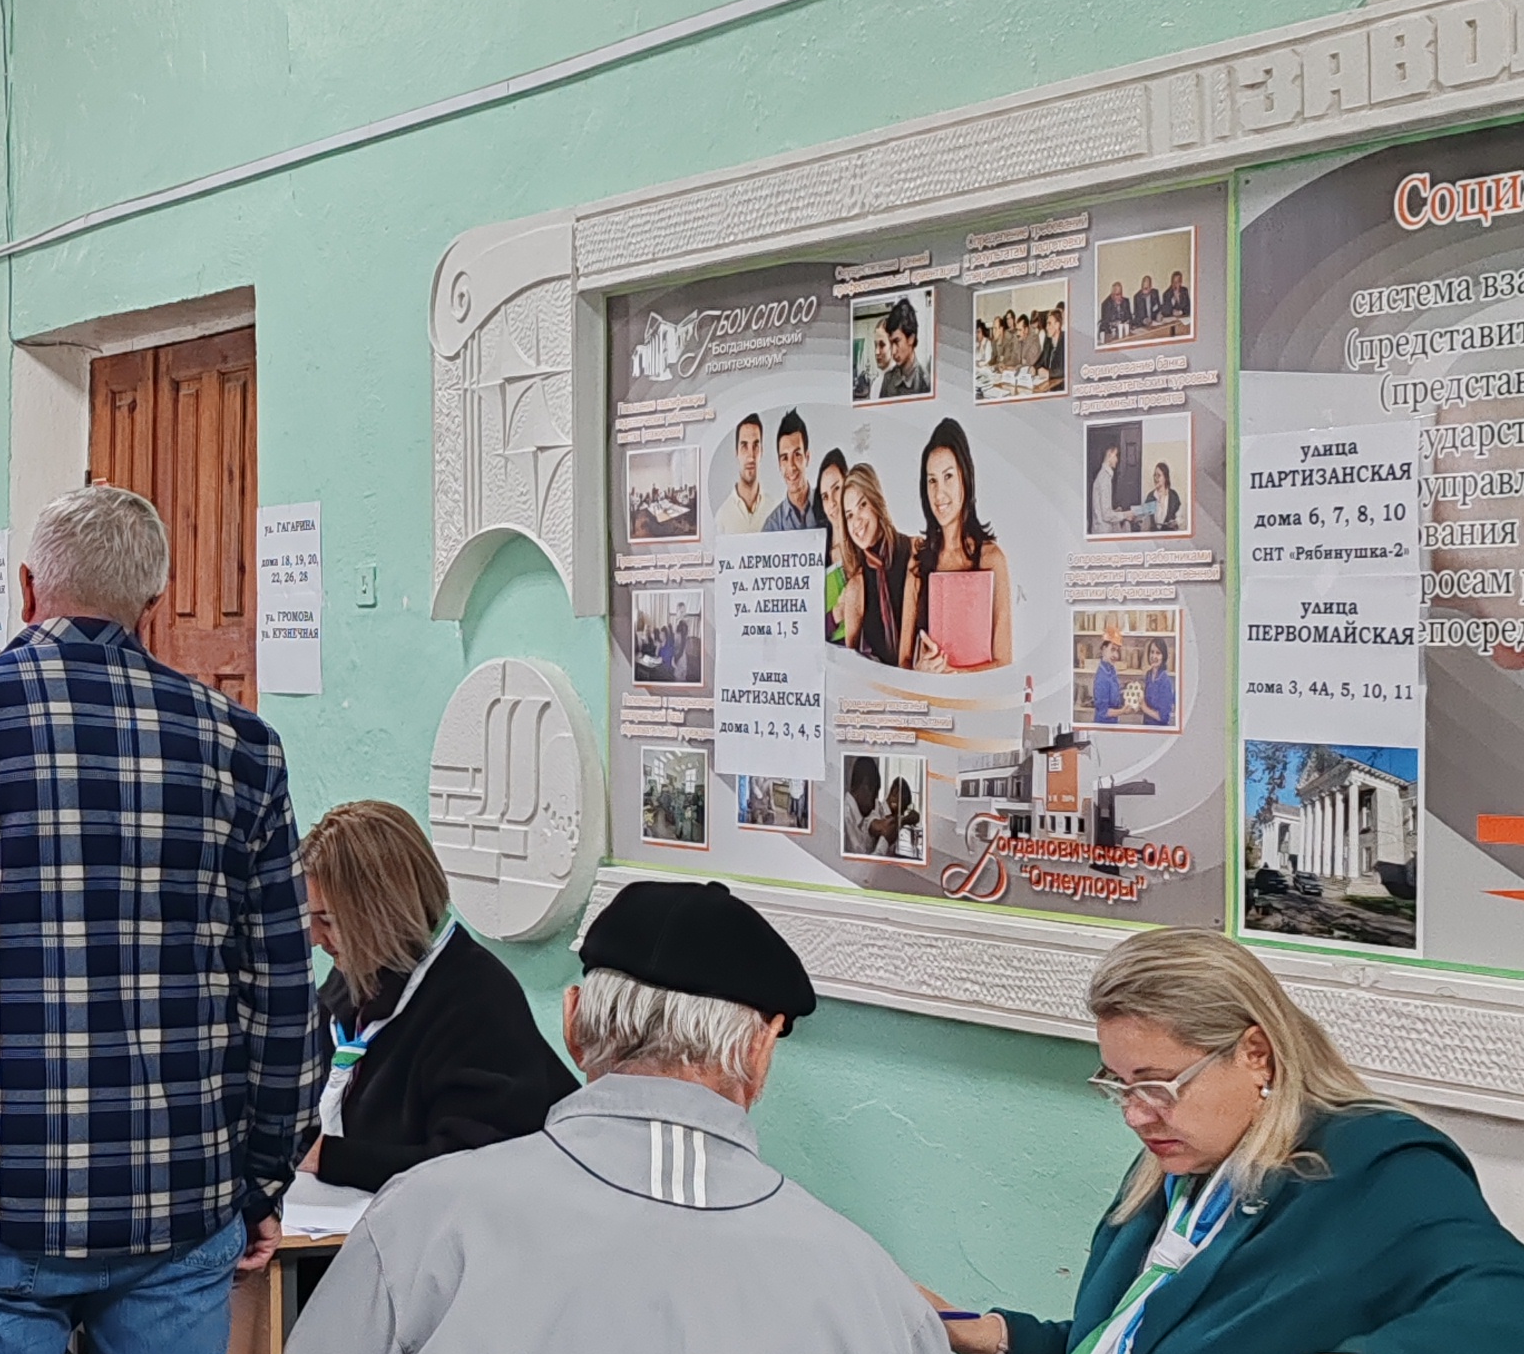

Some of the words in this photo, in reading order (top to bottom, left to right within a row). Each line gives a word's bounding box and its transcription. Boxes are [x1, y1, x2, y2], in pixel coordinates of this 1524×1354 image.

[1352, 278, 1472, 315] система
[750, 300, 789, 331] СПО
[789, 296, 817, 326] СО
[1300, 442, 1358, 462] улица
[1250, 463, 1412, 489] ПАРТИЗАНСКАЯ
[1254, 512, 1302, 529] дома
[1309, 508, 1325, 528] 6,
[1333, 506, 1349, 527] 7,
[1357, 505, 1375, 525] 8,
[1383, 504, 1406, 522] 10
[276, 520, 316, 533] ГАГАРИНА
[261, 558, 278, 568] дома
[281, 555, 292, 568] 18,
[295, 554, 306, 566] 19,
[308, 554, 319, 566] 20,
[1252, 547, 1284, 562] СНТ
[1289, 543, 1410, 563] «Рябинушка-2»
[719, 559, 734, 573] ул.
[739, 553, 824, 569] ЛЕРМОНТОВА
[271, 572, 282, 584] 22,
[284, 571, 296, 584] 26,
[732, 581, 748, 595] ул.
[752, 576, 810, 591] ЛУГОВАЯ
[277, 611, 314, 622] ГРОМОВА
[734, 603, 750, 617] ул.
[755, 599, 807, 613] ЛЕНИНА
[1300, 601, 1358, 618] улица
[742, 625, 772, 637] дома
[776, 622, 787, 638] 1,
[791, 621, 799, 635] 5
[1247, 621, 1415, 645] ПЕРВОМАЙСКАЯ
[752, 671, 788, 686] улица
[721, 688, 821, 707] ПАРТИЗАНСКАЯ
[1246, 682, 1283, 694] дома
[1289, 681, 1303, 698] 3,
[1309, 681, 1334, 699] 4А,
[1341, 682, 1355, 700] 5,
[1363, 683, 1387, 701] 10,
[1394, 685, 1413, 699] 11
[719, 721, 749, 734] дома
[754, 721, 764, 738] 1,
[767, 722, 779, 738] 2,
[783, 722, 794, 739] 3,
[798, 723, 810, 739] 4,
[814, 724, 821, 738] 5
[1142, 843, 1191, 873] ОАО
